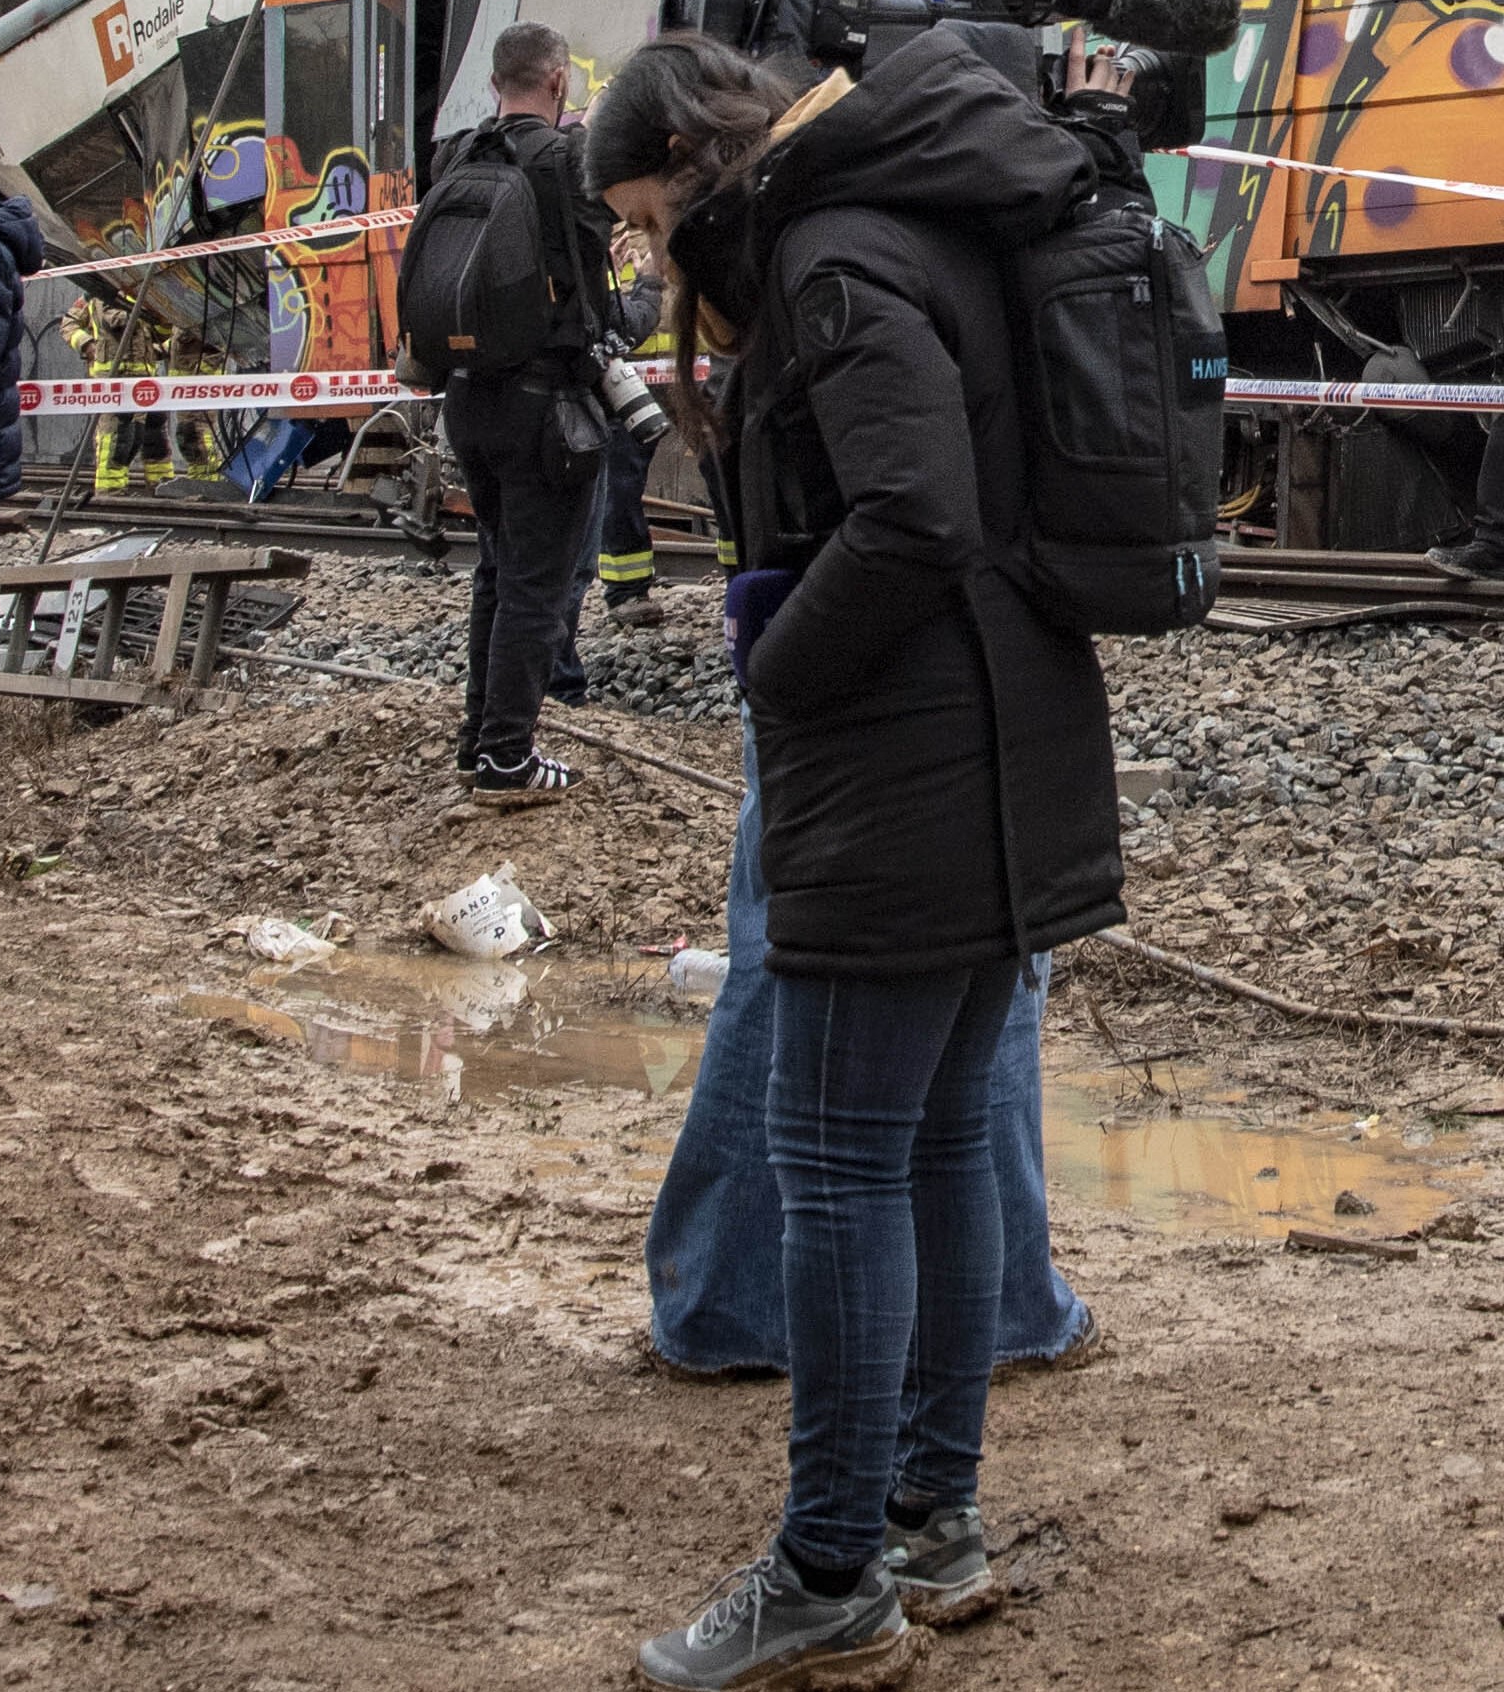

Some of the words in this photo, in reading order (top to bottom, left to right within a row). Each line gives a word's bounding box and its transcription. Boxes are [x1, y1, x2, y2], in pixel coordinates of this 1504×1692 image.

[136, 389, 156, 401] 112
[171, 383, 246, 400] PASSEU
[251, 383, 279, 398] NO
[329, 385, 399, 398] bombers
[53, 393, 122, 407] bombers
